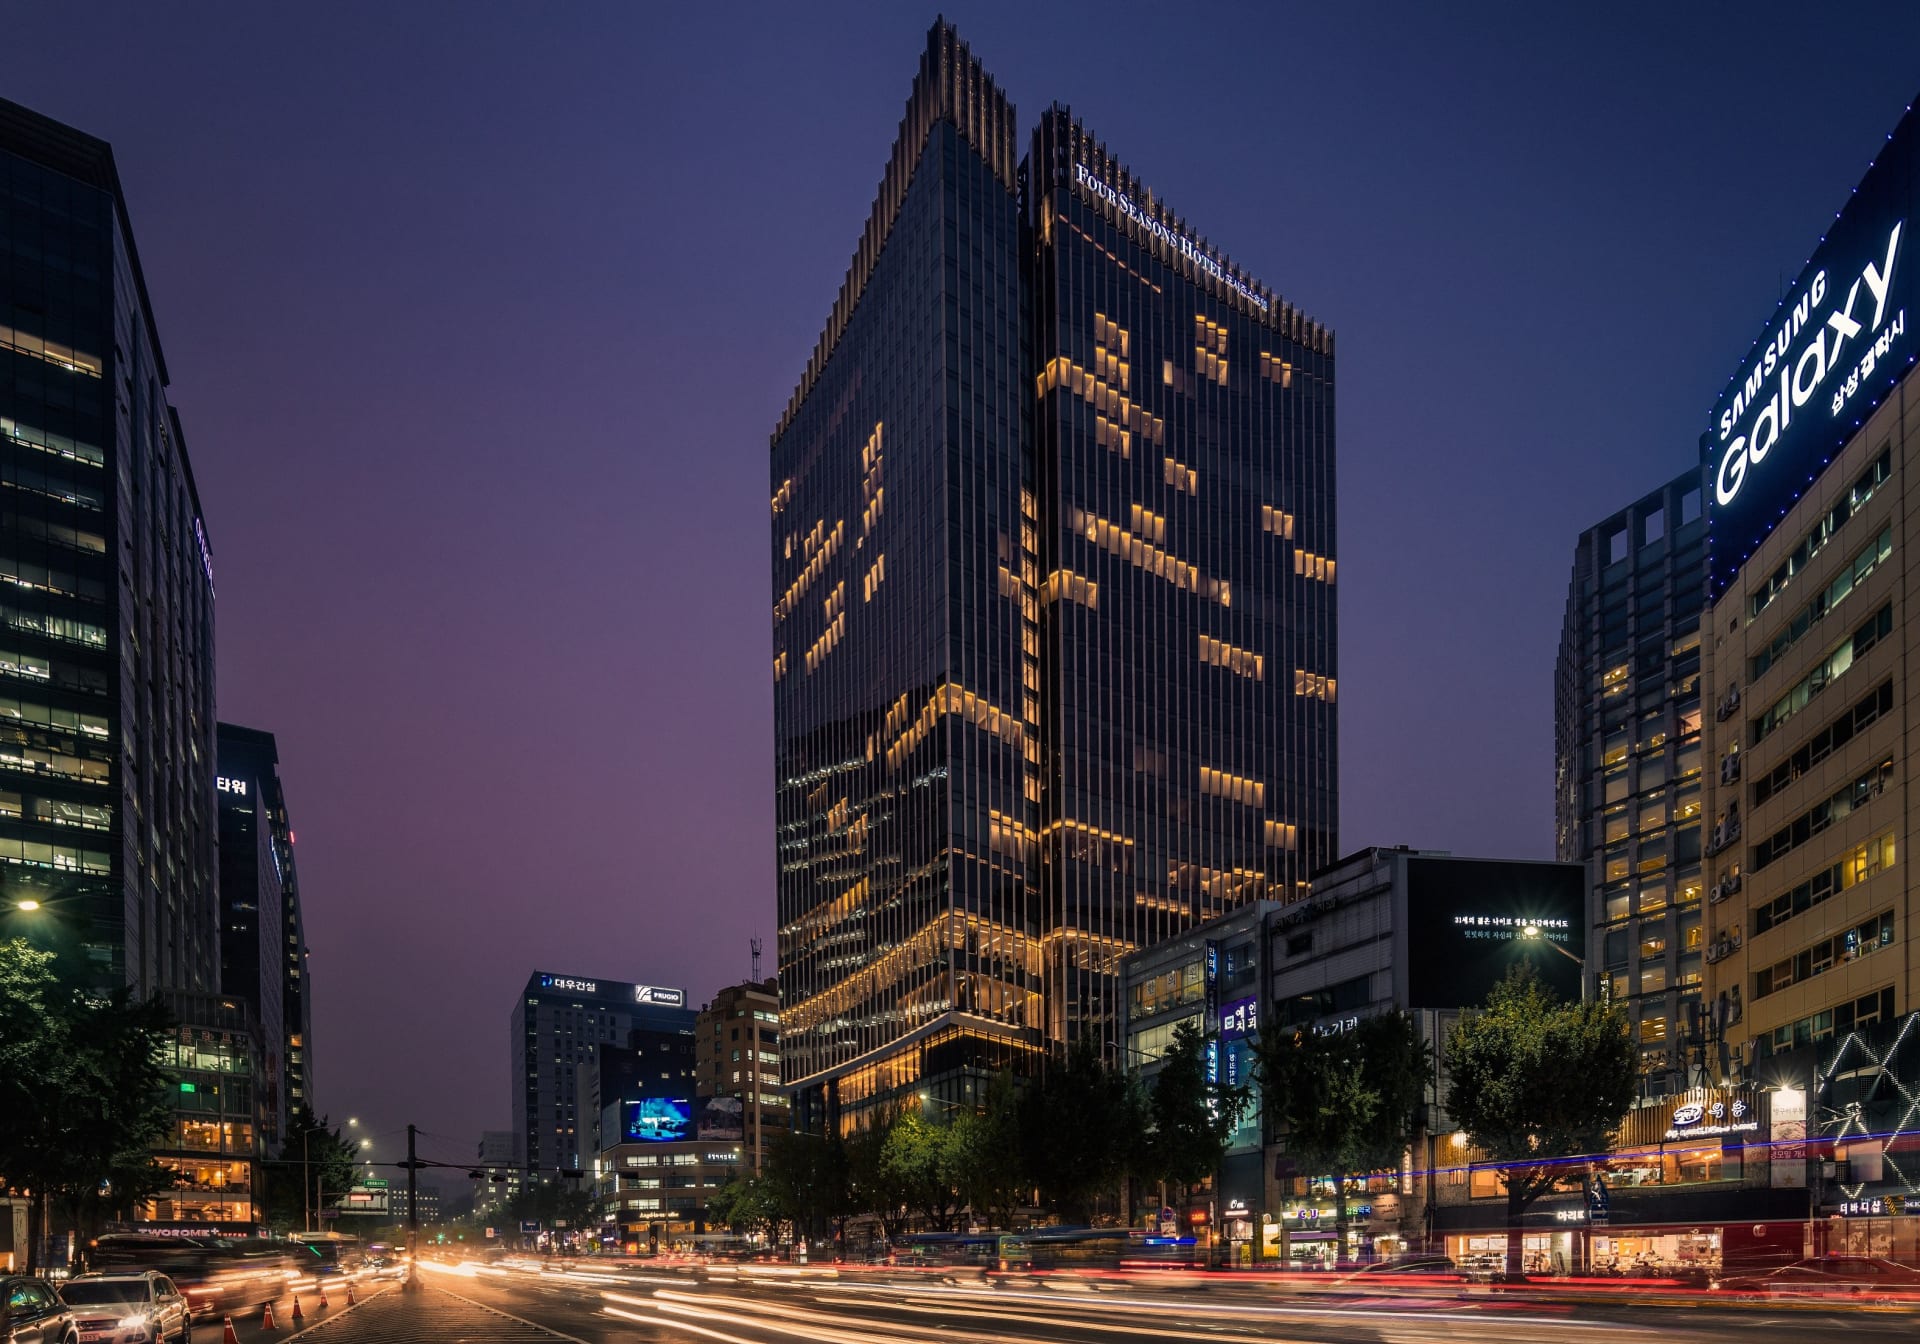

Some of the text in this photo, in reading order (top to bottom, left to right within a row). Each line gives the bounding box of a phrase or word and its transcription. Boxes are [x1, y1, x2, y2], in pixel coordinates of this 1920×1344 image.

[1075, 163, 1225, 282] FOUR SEASONS HOTEL
[1715, 220, 1902, 506] Galaxy
[1719, 269, 1827, 441] SAMSUNG
[216, 776, 247, 796] 타워
[554, 978, 597, 993] 대우건설
[1839, 1200, 1882, 1215] 더바디샵
